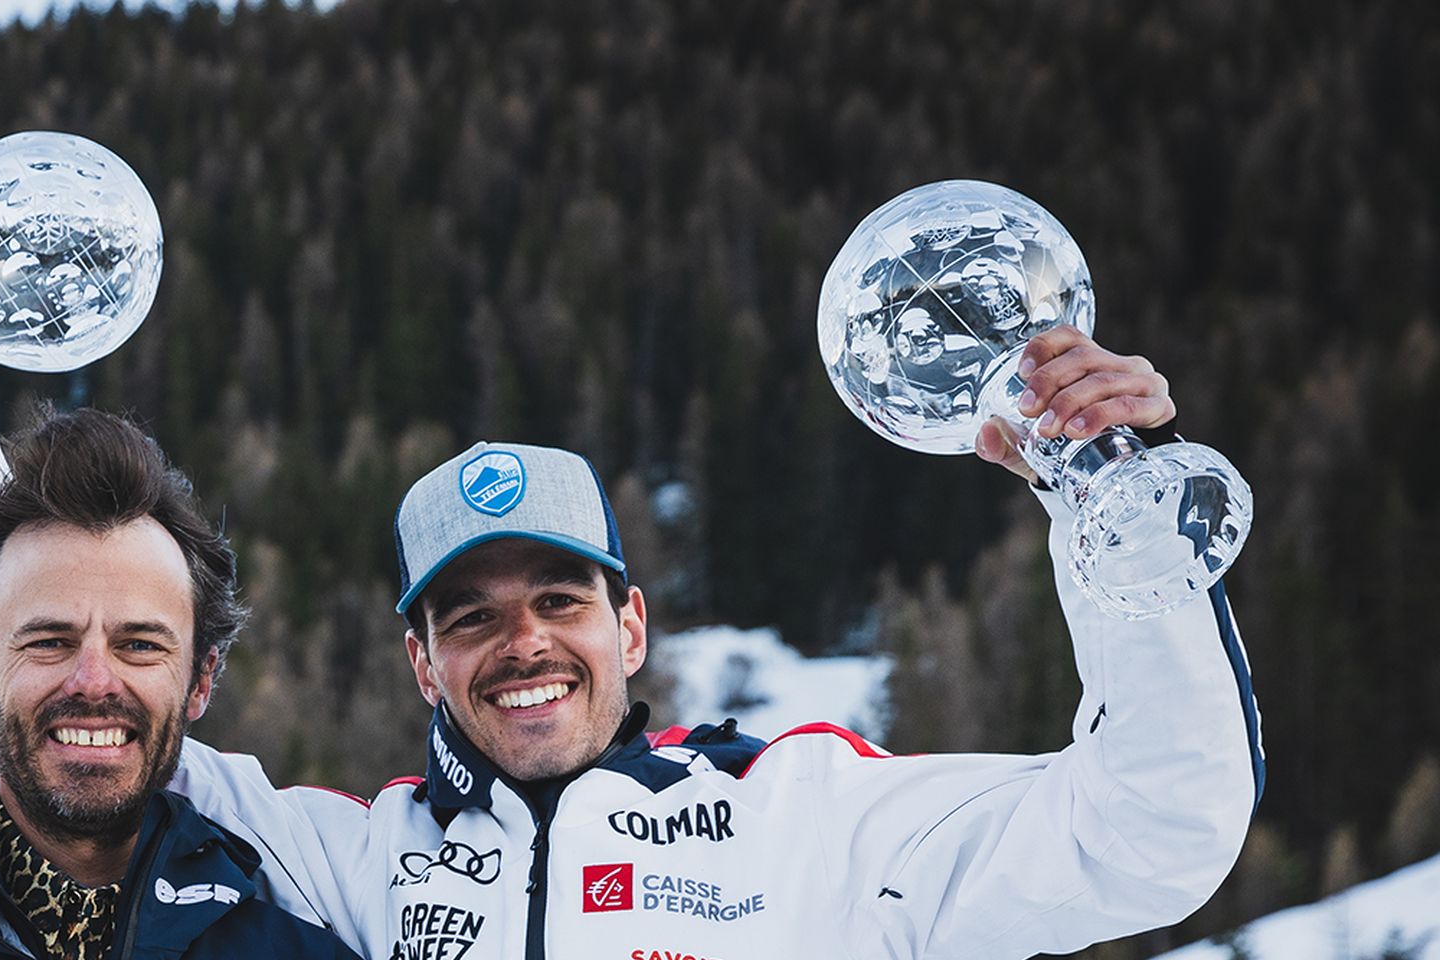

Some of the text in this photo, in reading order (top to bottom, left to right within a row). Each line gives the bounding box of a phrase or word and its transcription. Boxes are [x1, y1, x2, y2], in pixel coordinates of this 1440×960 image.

[433, 725, 474, 795] COLM
[608, 800, 734, 845] COLMAR
[642, 874, 722, 902] CAISSE
[643, 893, 766, 922] D'EPARGNE
[401, 903, 485, 942] GREEN
